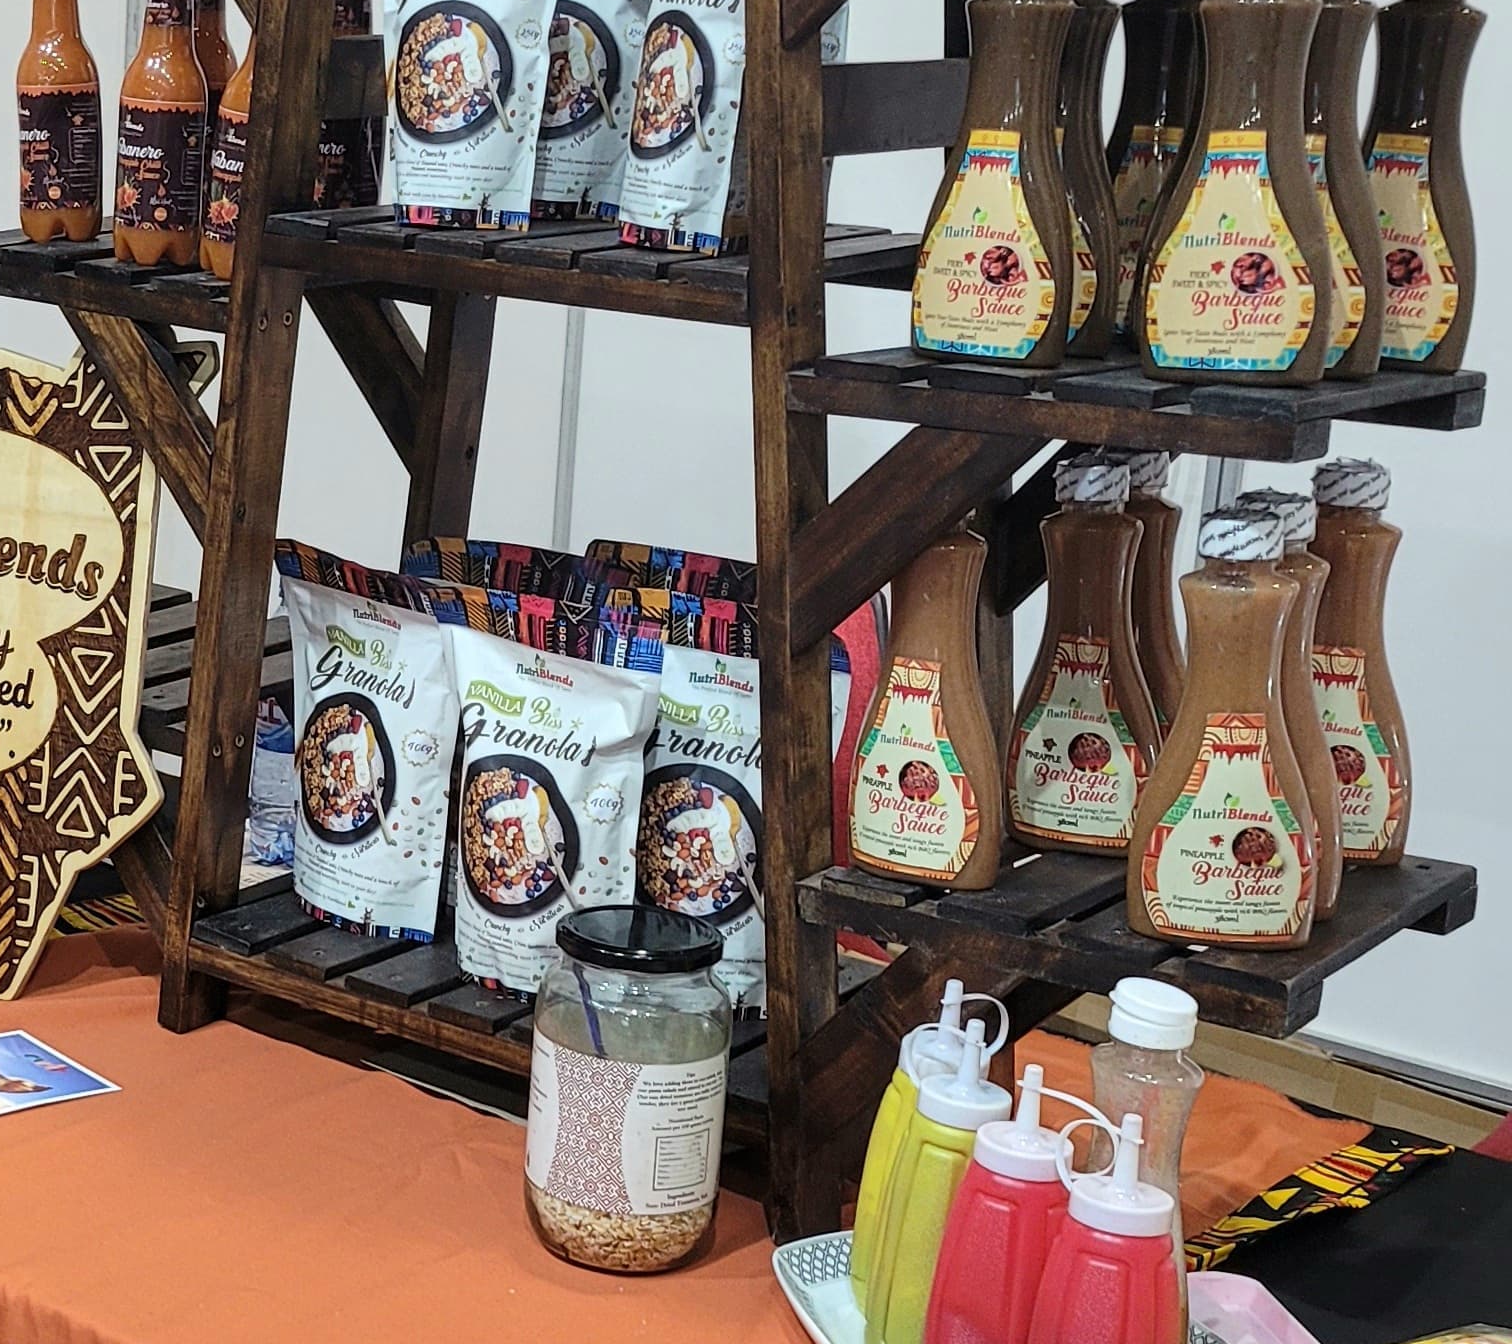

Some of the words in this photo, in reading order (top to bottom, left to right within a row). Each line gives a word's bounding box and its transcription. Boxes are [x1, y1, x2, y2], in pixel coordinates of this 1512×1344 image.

[20, 129, 51, 141] nero
[947, 278, 1027, 303] Barbeque
[1386, 288, 1429, 304] eque
[971, 297, 1025, 319] Sauce
[1192, 290, 1285, 316] Barbeque
[1386, 304, 1426, 319] auce
[1223, 308, 1283, 331] Sauce
[310, 645, 406, 703] Granola
[470, 684, 522, 713] VANILLA
[658, 698, 697, 721] NILLA
[461, 702, 582, 762] Granola
[1324, 722, 1363, 736] Blends
[643, 714, 762, 769] ranol
[1060, 784, 1119, 805] Sauce
[1342, 803, 1371, 816] uce
[891, 813, 947, 835] Sauce
[1180, 848, 1225, 861] PINEAPPLE
[1192, 861, 1285, 886] Barbeque
[1225, 879, 1284, 901] Sauce
